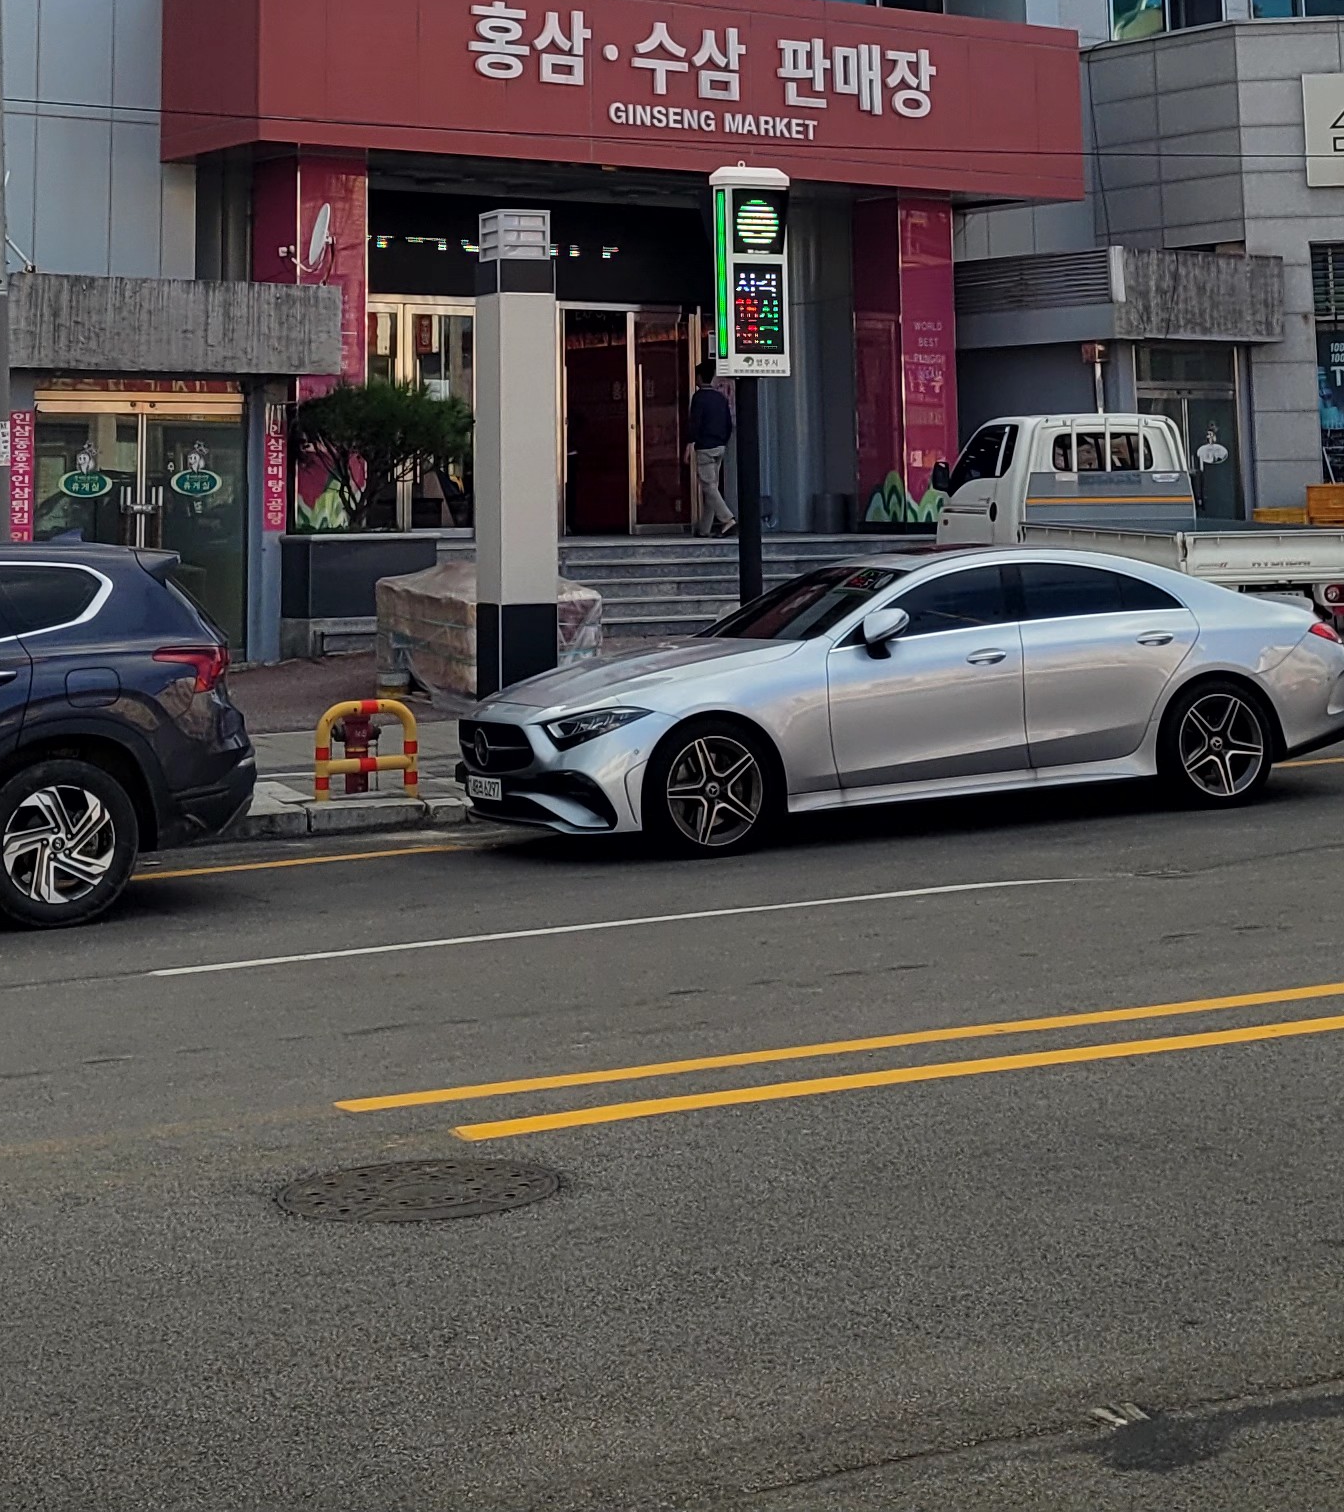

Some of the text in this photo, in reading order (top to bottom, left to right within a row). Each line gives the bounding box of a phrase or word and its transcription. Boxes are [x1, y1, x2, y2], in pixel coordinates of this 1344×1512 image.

[776, 37, 937, 119] 판매장
[608, 101, 819, 141] GINSENG MARKET
